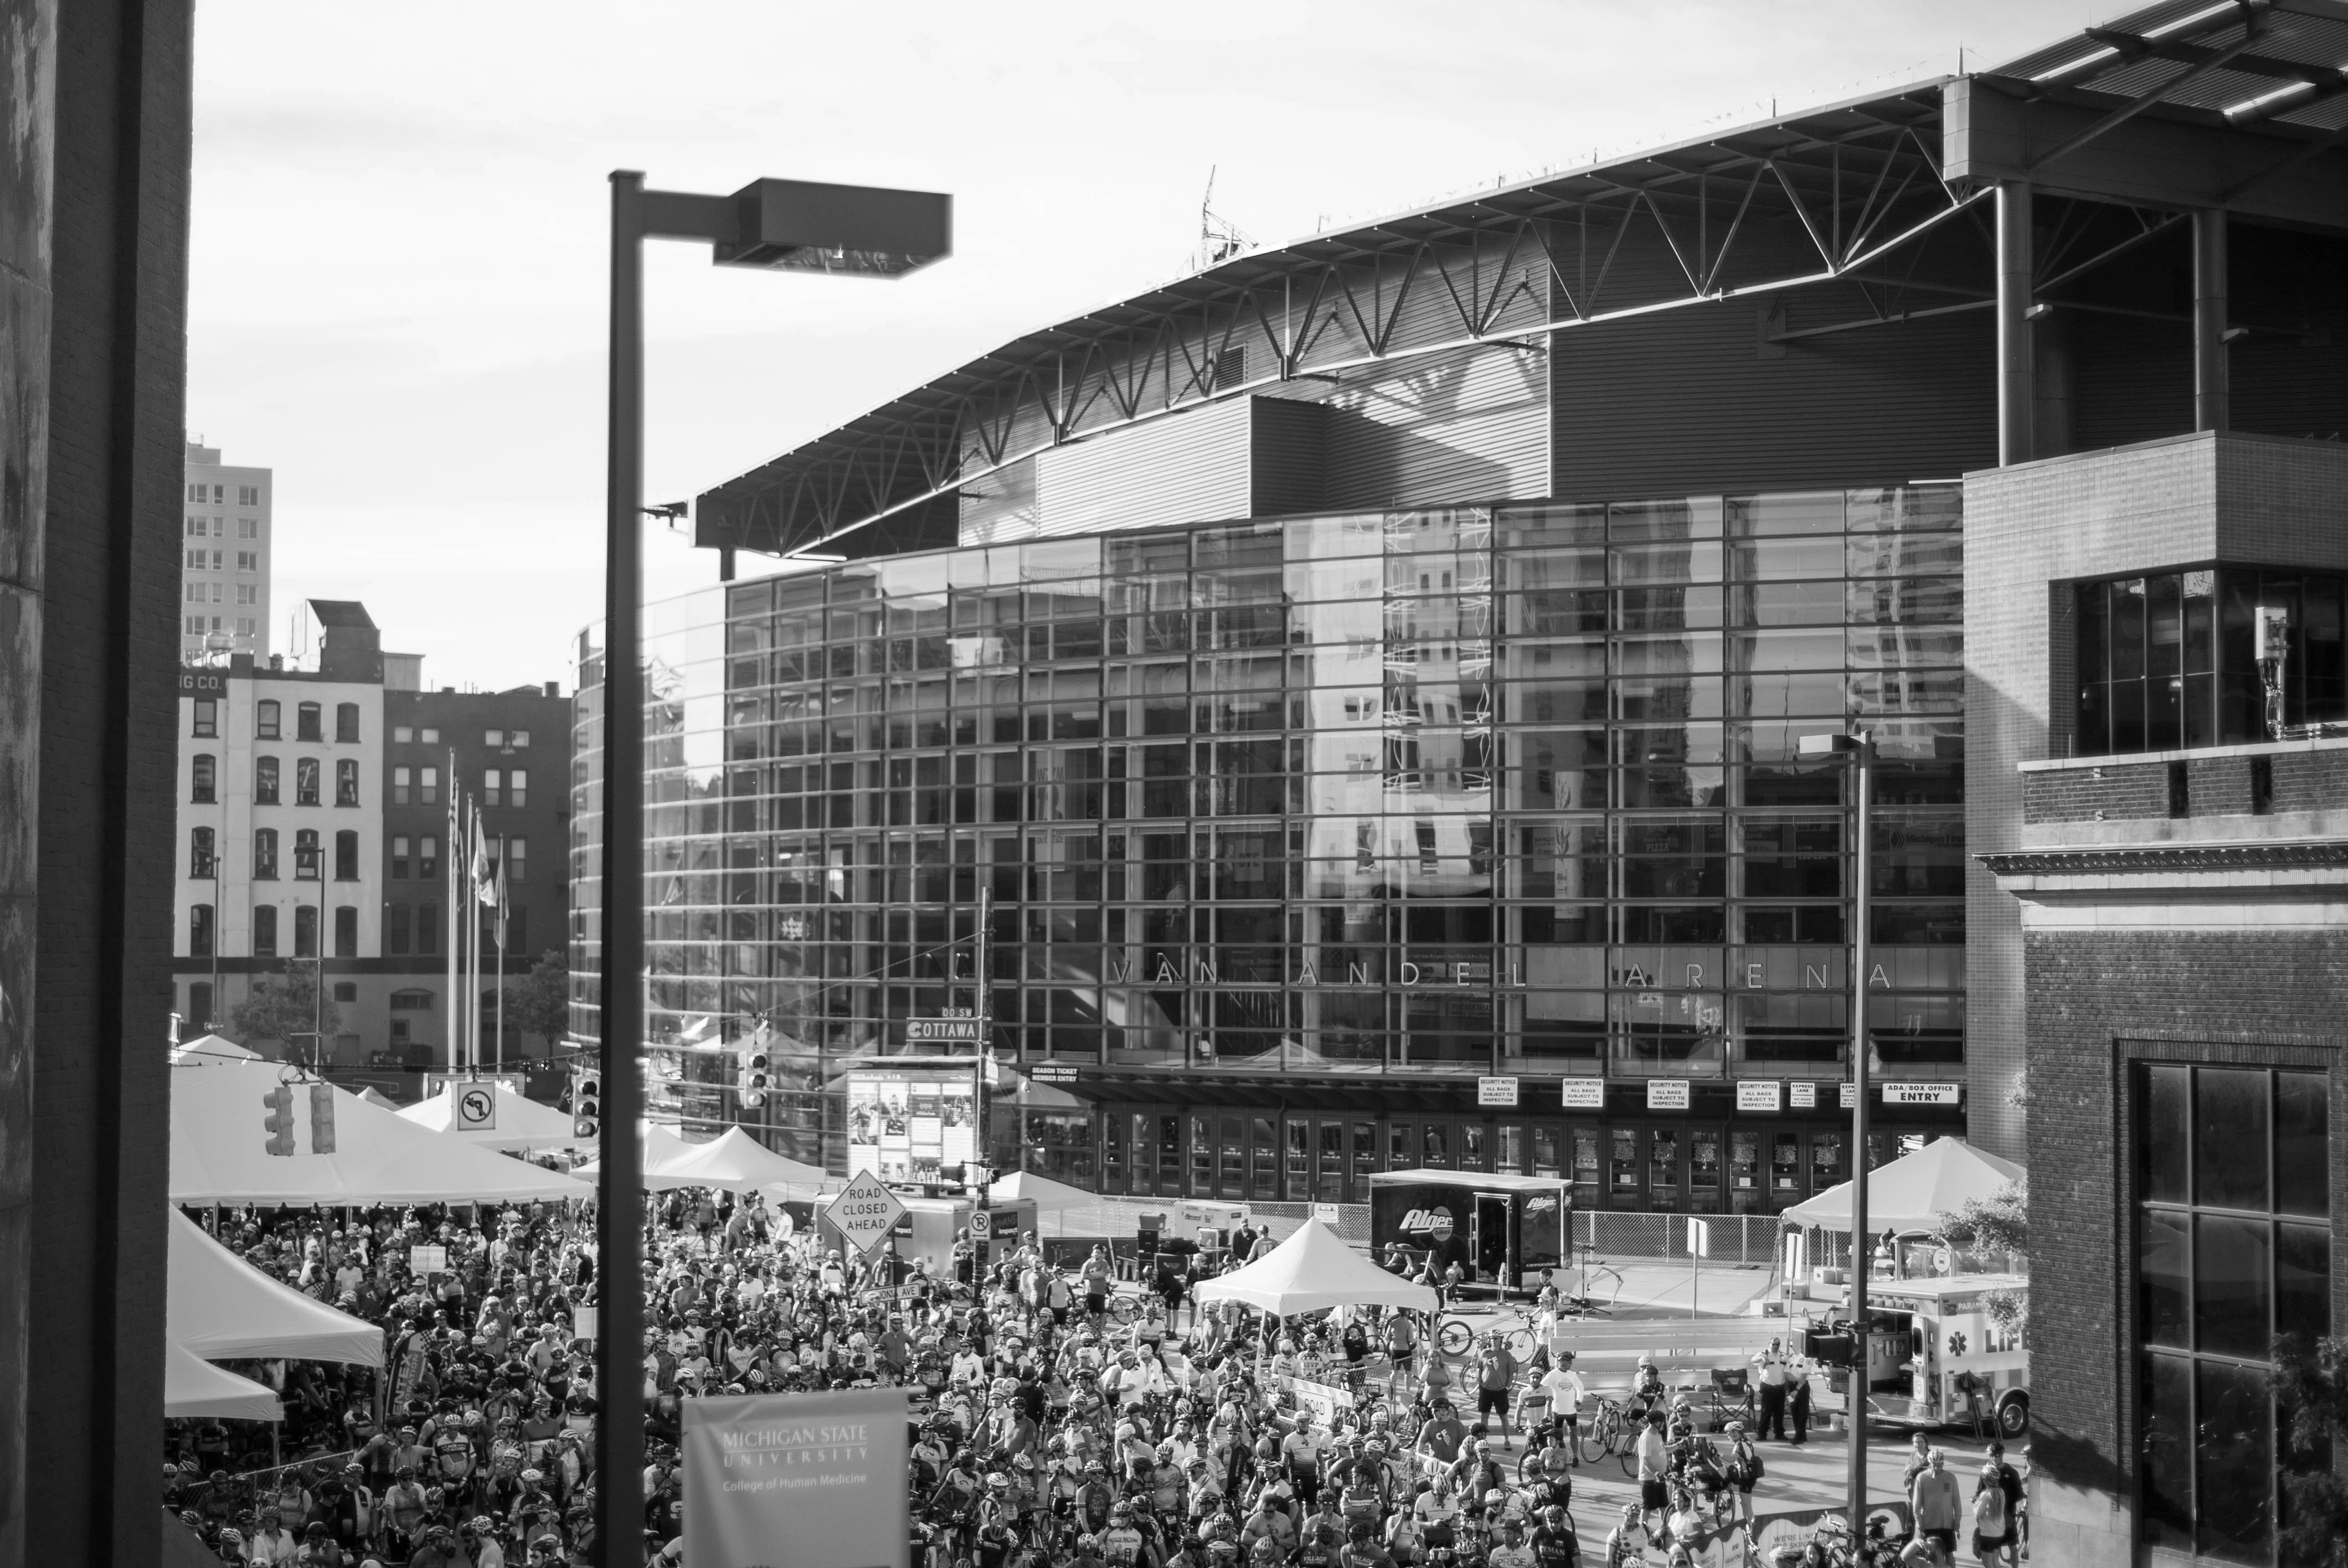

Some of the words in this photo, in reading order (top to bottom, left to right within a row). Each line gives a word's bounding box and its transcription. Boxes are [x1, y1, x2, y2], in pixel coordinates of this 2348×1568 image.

[198, 676, 222, 689] CO.
[1906, 833, 1944, 844] Michigan
[1646, 842, 1669, 852] PIZZA
[1113, 961, 1217, 983] VAN
[1298, 961, 1526, 986] ANDEL
[1625, 963, 1890, 988] ARENA
[959, 1008, 972, 1018] SW
[923, 1023, 975, 1037] OTTAWA
[1901, 1093, 1940, 1101] ENTRY
[849, 1188, 881, 1199] ROAD
[843, 1203, 887, 1215] CLOSED
[1526, 1198, 1557, 1210] Alger
[847, 1219, 886, 1230] AHEAD
[1399, 1209, 1453, 1234] Alger
[902, 1286, 916, 1296] AVE
[392, 1352, 412, 1416] ENTEX
[1305, 1399, 1325, 1415] ROAD
[723, 1428, 814, 1448] MICHIGAN
[821, 1425, 868, 1443] STATE
[724, 1447, 867, 1467] UNIVERSITY
[723, 1479, 763, 1493] College
[766, 1478, 776, 1489] of
[780, 1477, 817, 1489] Human
[820, 1472, 866, 1486] Medicine
[1497, 1557, 1527, 1567] PRIDE
